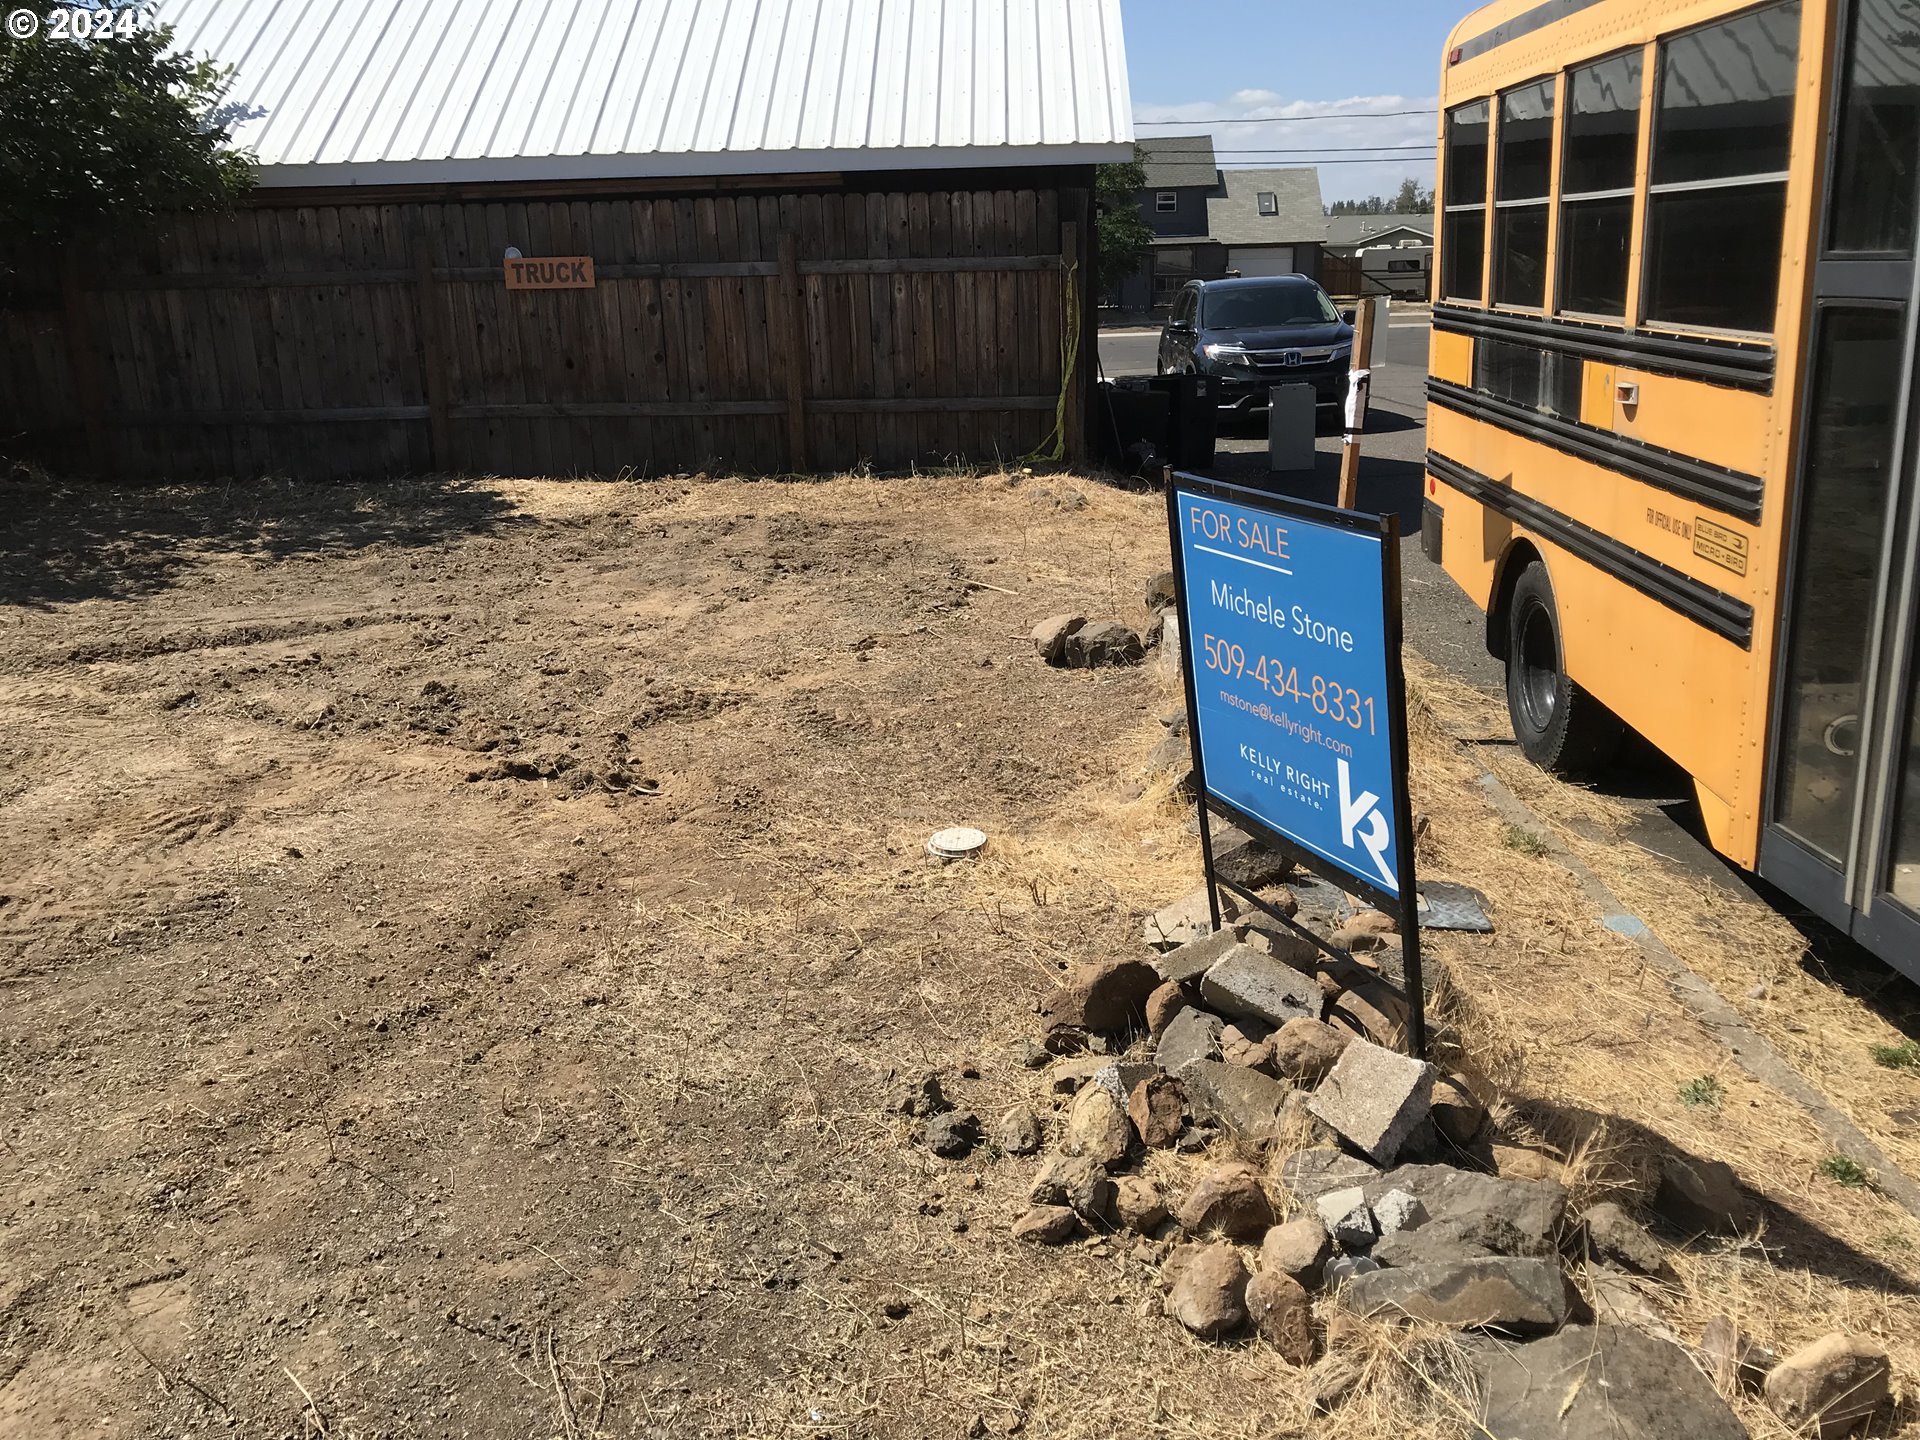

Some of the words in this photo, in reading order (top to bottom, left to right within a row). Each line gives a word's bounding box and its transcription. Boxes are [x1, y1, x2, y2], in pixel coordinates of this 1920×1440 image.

[511, 262, 587, 284] TRUCK
[1190, 506, 1232, 543] FOR
[1237, 517, 1290, 560] SALE
[1697, 524, 1713, 536] BLUE
[1714, 530, 1728, 542] BIRD
[1210, 578, 1286, 629] Michele
[1291, 605, 1354, 653] Stone
[1204, 633, 1375, 736] 509-434-8331
[1220, 690, 1353, 758] mstone@kellyright.com
[1240, 743, 1281, 775] KELLY
[1286, 765, 1331, 799] RIGHT
[1251, 769, 1274, 787] real
